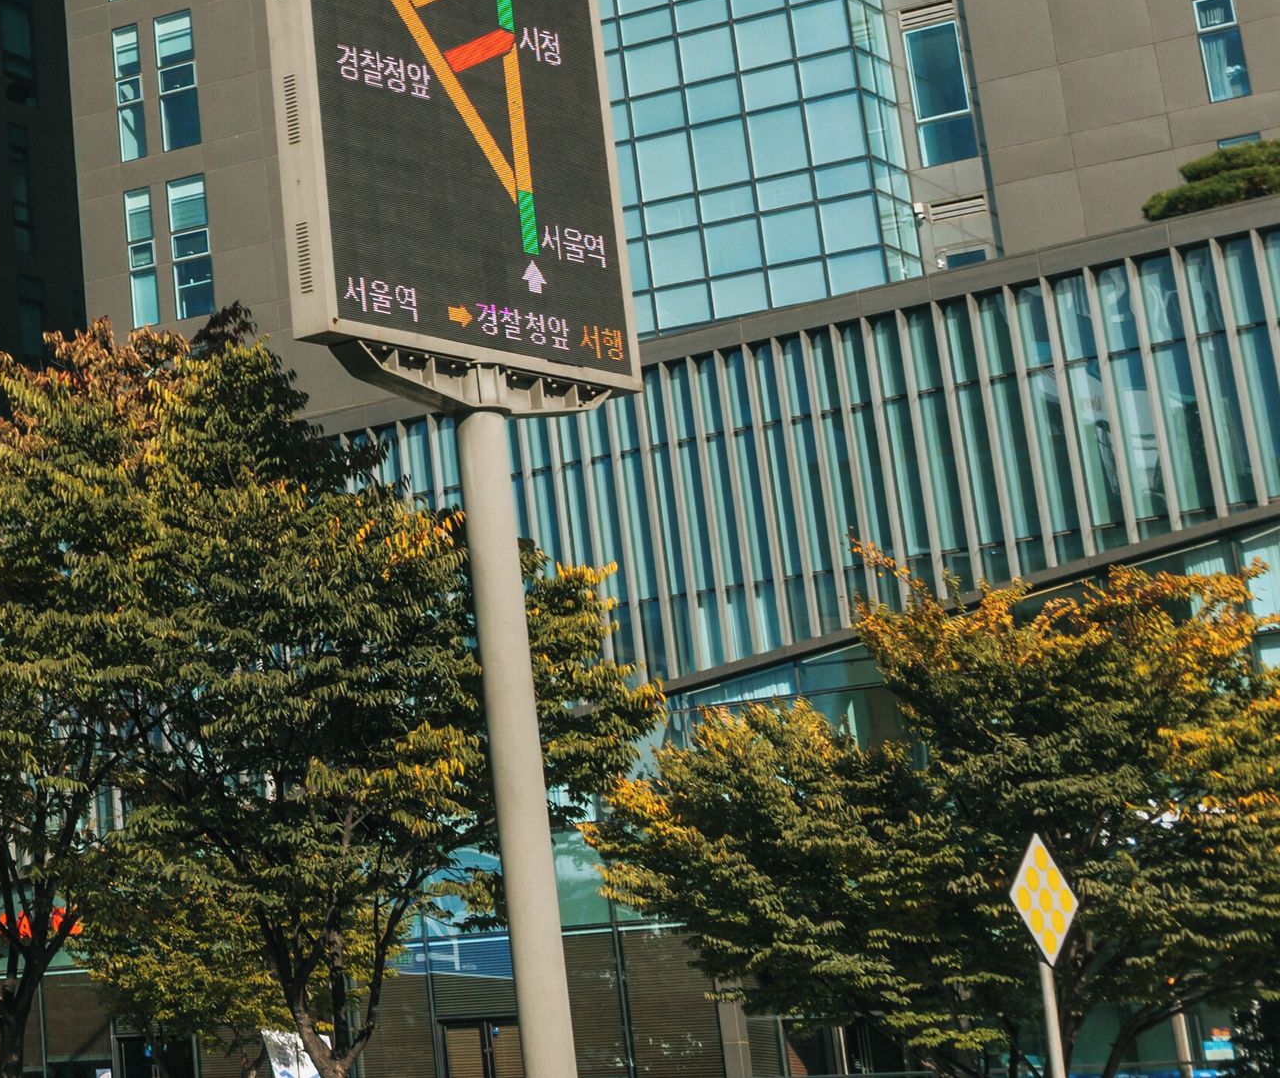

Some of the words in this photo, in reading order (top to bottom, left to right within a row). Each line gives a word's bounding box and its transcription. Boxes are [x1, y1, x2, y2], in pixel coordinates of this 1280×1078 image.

[519, 27, 562, 67] 시청
[336, 44, 431, 100] 경찰청앞
[541, 225, 607, 269] 서울역
[343, 277, 419, 324] 서울역
[474, 301, 571, 352] 경찰청앞
[579, 324, 624, 362] 서행
